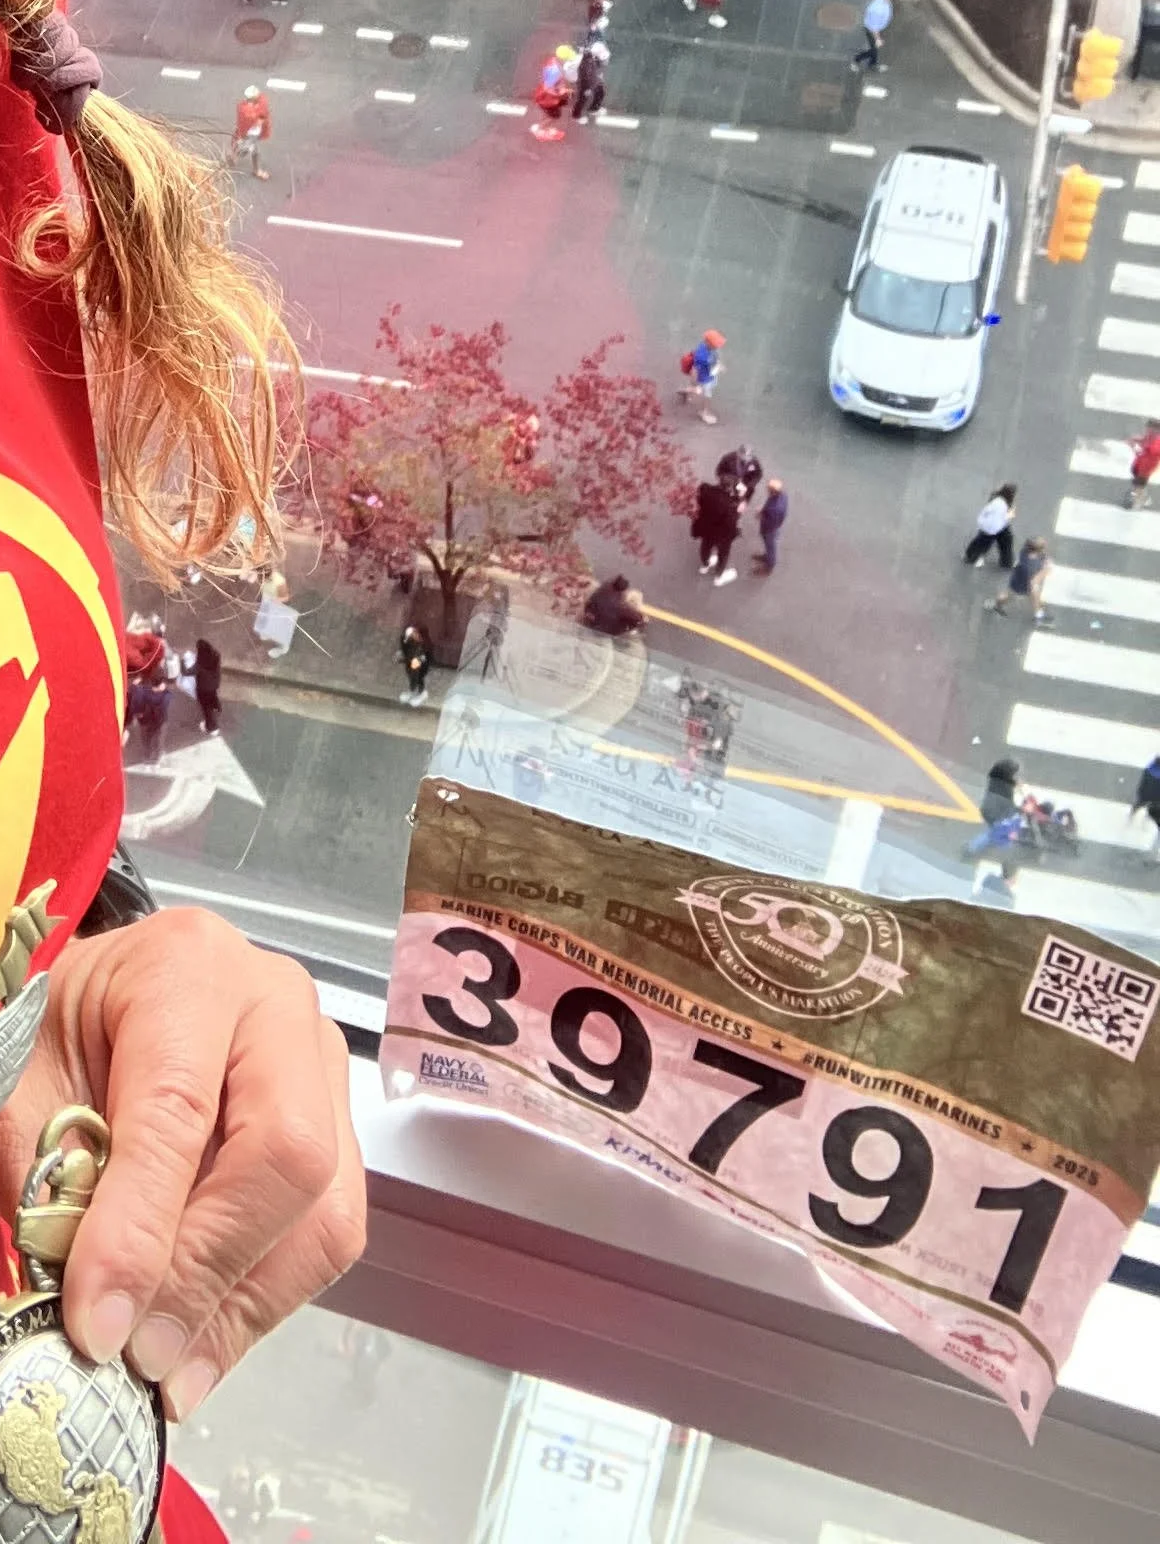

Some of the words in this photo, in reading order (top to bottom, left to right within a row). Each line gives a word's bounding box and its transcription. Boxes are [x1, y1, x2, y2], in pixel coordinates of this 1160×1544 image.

[740, 931, 829, 980] Anniversary
[783, 987, 864, 1011] MARATHON
[422, 1052, 466, 1068] NAVY
[441, 899, 504, 926] MARINE
[508, 917, 560, 949] CORPS
[565, 939, 598, 969] WAR
[602, 960, 684, 1013] MEMORIAL
[689, 1004, 754, 1041] ACCESS
[802, 1051, 1003, 1140] #RUNWITHTHEMARINES
[1053, 1154, 1100, 1187] 2025
[422, 1063, 487, 1083] FEDERAL
[422, 927, 1068, 1314] 39791
[605, 1137, 683, 1183] KPMG
[540, 1444, 629, 1494] 835
